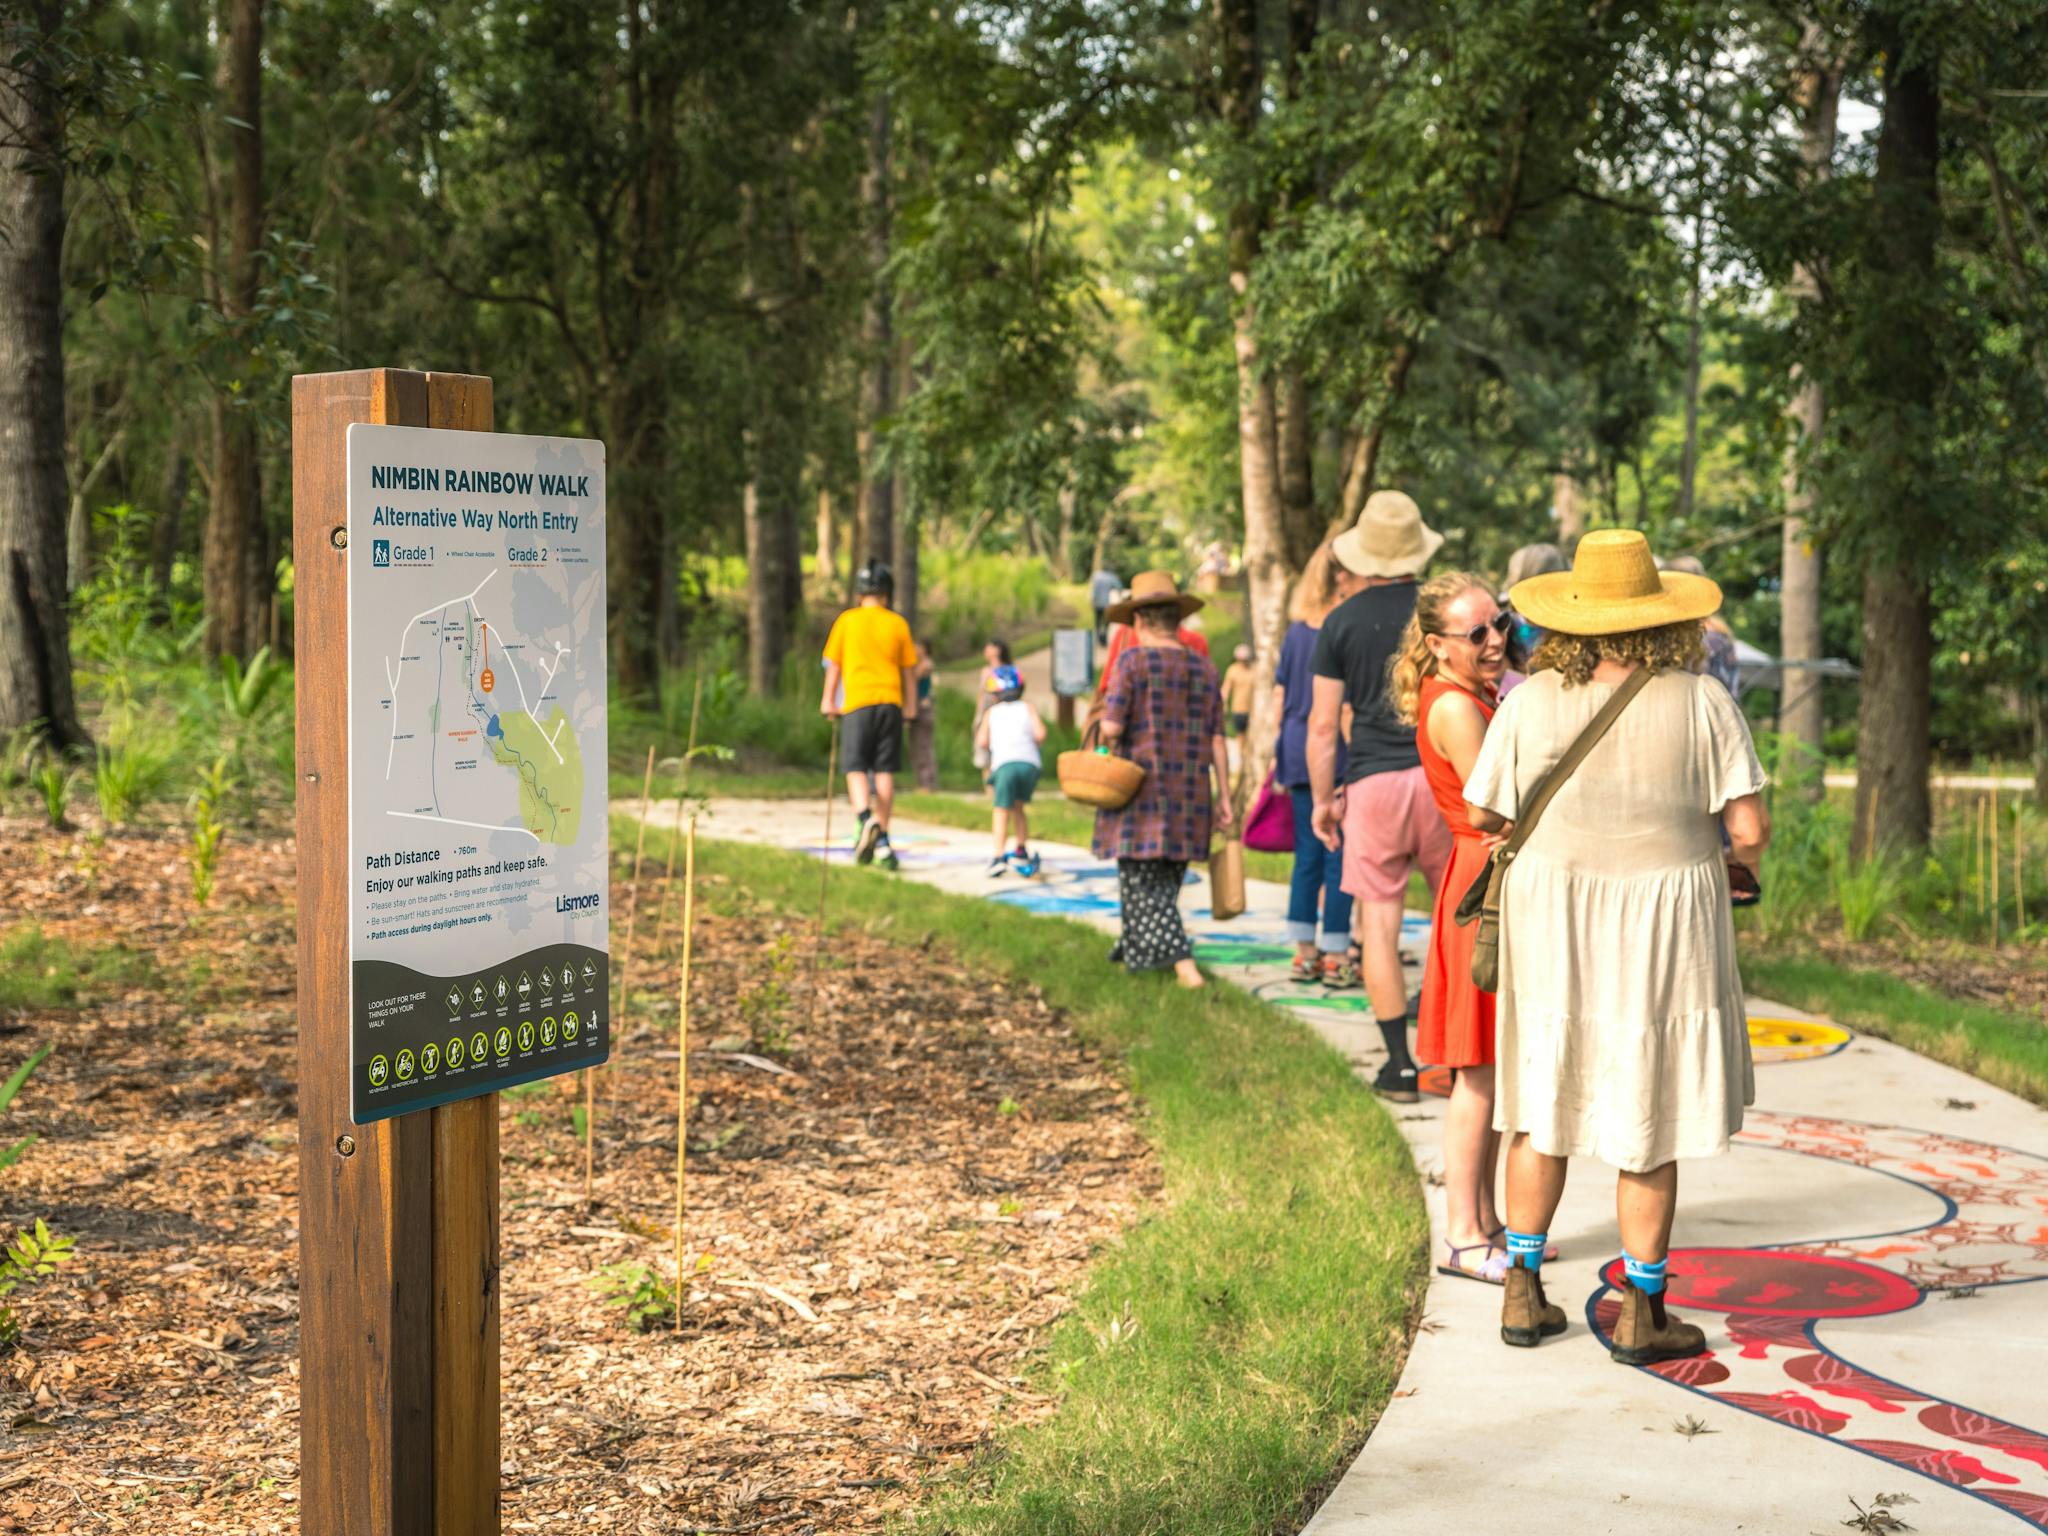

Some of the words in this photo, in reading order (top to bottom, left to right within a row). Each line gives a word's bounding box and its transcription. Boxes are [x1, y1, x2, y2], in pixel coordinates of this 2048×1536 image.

[372, 466, 439, 491] NIMBIN
[445, 469, 533, 495] RAINBOW
[538, 474, 589, 497] WALK
[373, 506, 457, 527] Alternative
[462, 509, 493, 532] Way
[498, 510, 538, 529] North
[542, 511, 578, 533] Entry
[394, 546, 427, 560] Grade
[430, 546, 434, 560] 1
[508, 548, 538, 561] Grade
[542, 548, 547, 561] 2
[458, 846, 476, 856] 760m
[366, 854, 390, 870] Path
[394, 850, 440, 866] Distance
[366, 878, 394, 894] Enjoy
[397, 876, 414, 888] our
[416, 870, 454, 885] walking
[456, 866, 482, 882] paths
[484, 861, 500, 876] and
[504, 860, 524, 872] keep
[528, 856, 548, 868] safe.
[454, 889, 470, 898] Bring
[472, 887, 488, 895] water
[490, 884, 500, 893] and
[502, 882, 514, 892] stay
[371, 902, 391, 910] Please
[393, 899, 406, 908] stay
[556, 893, 600, 913] Lismore
[371, 917, 380, 926] Be
[381, 911, 415, 924] sun-smart!
[416, 910, 430, 918] Hats
[432, 908, 444, 916] and
[444, 902, 475, 913] sunscreen
[570, 911, 580, 920] City
[372, 931, 387, 940] Path
[388, 928, 409, 937] access
[410, 922, 432, 934] during
[432, 918, 458, 930] daylight
[460, 916, 477, 925] hours
[478, 912, 493, 922] only.
[368, 1000, 384, 1010] LOOK
[384, 998, 396, 1006] OUT
[397, 995, 408, 1003] FOR
[410, 992, 426, 1000] THESE
[369, 1009, 388, 1018] THINGS
[389, 1007, 398, 1015] ON
[398, 1004, 414, 1012] YOUR
[368, 1019, 384, 1028] WALK
